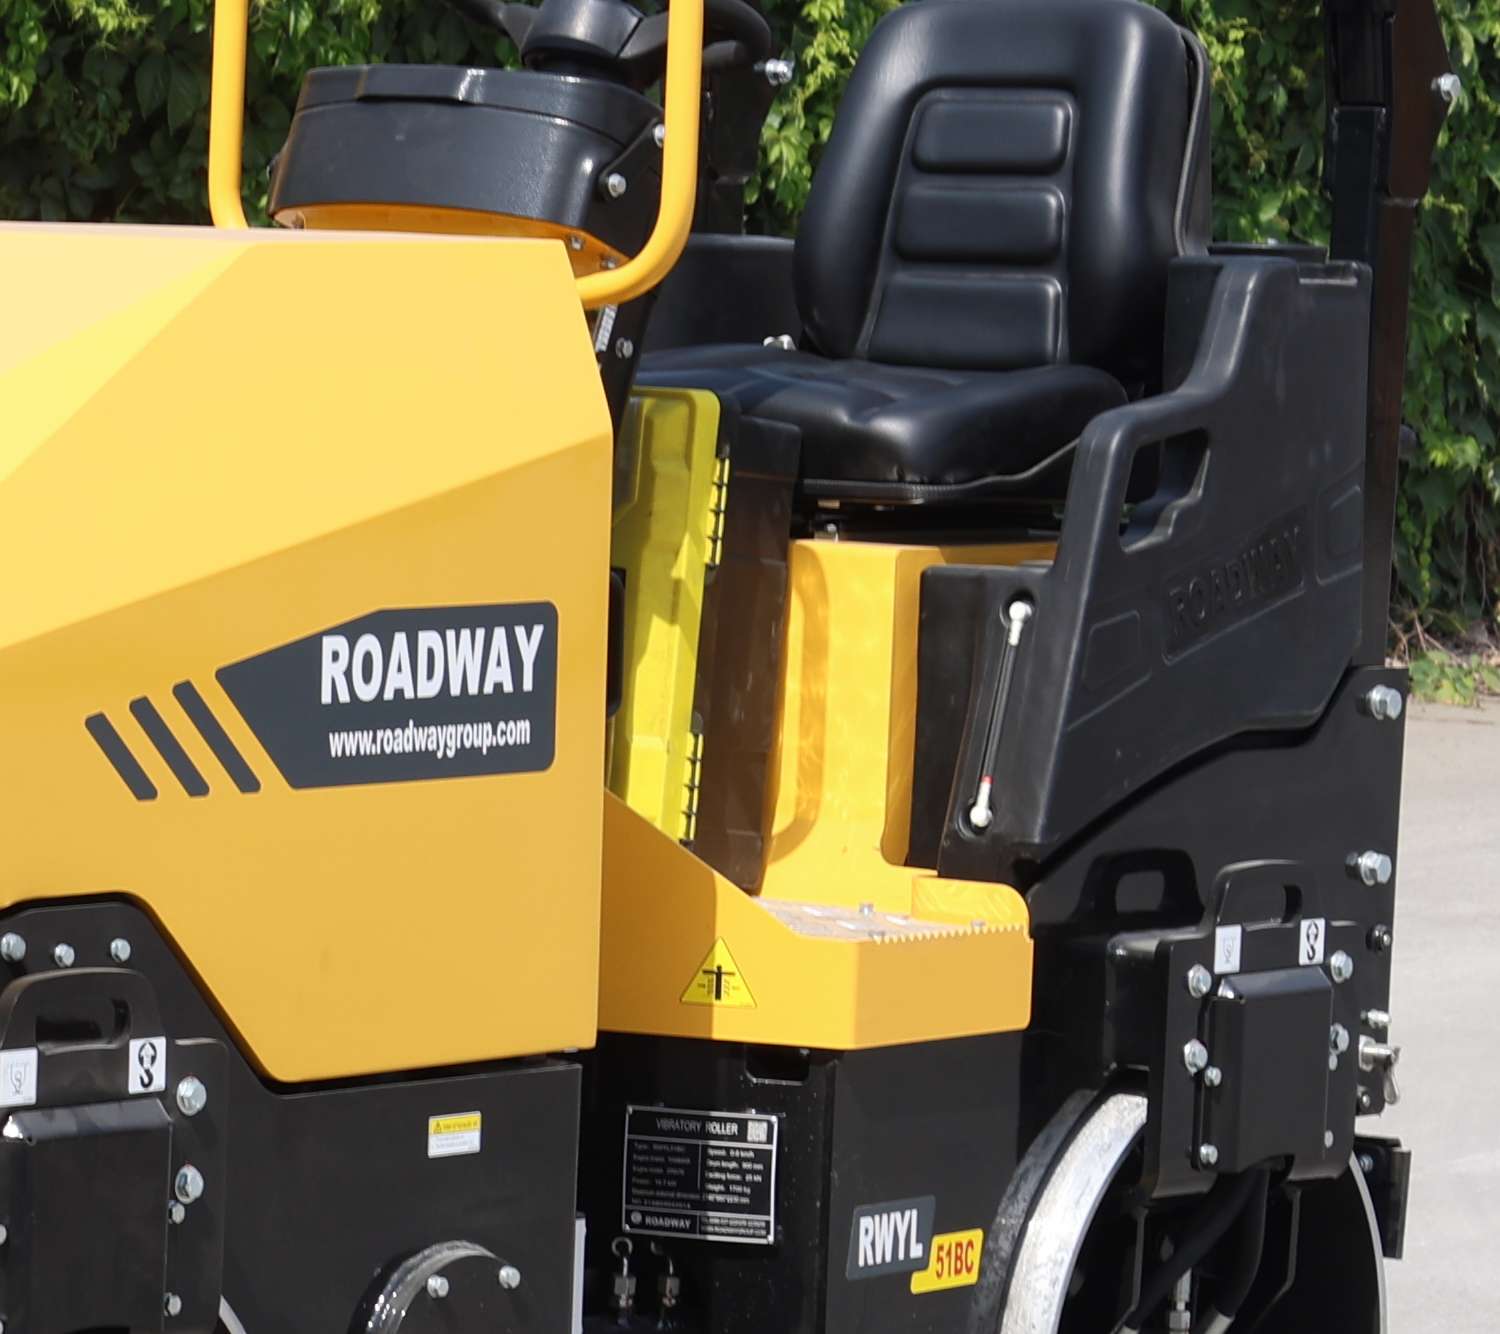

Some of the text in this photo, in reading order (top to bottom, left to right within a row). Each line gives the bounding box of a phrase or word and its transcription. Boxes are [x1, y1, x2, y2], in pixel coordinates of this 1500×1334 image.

[1169, 526, 1299, 637] ROADWAY
[321, 624, 544, 705] ROADWAY
[329, 719, 531, 760] www.roadwaygroup.com
[656, 1117, 739, 1136] VIBRATORY ROLLER
[645, 1214, 692, 1230] ROADWAY
[858, 1208, 923, 1268] RWYL
[936, 1238, 974, 1279] 51BC
